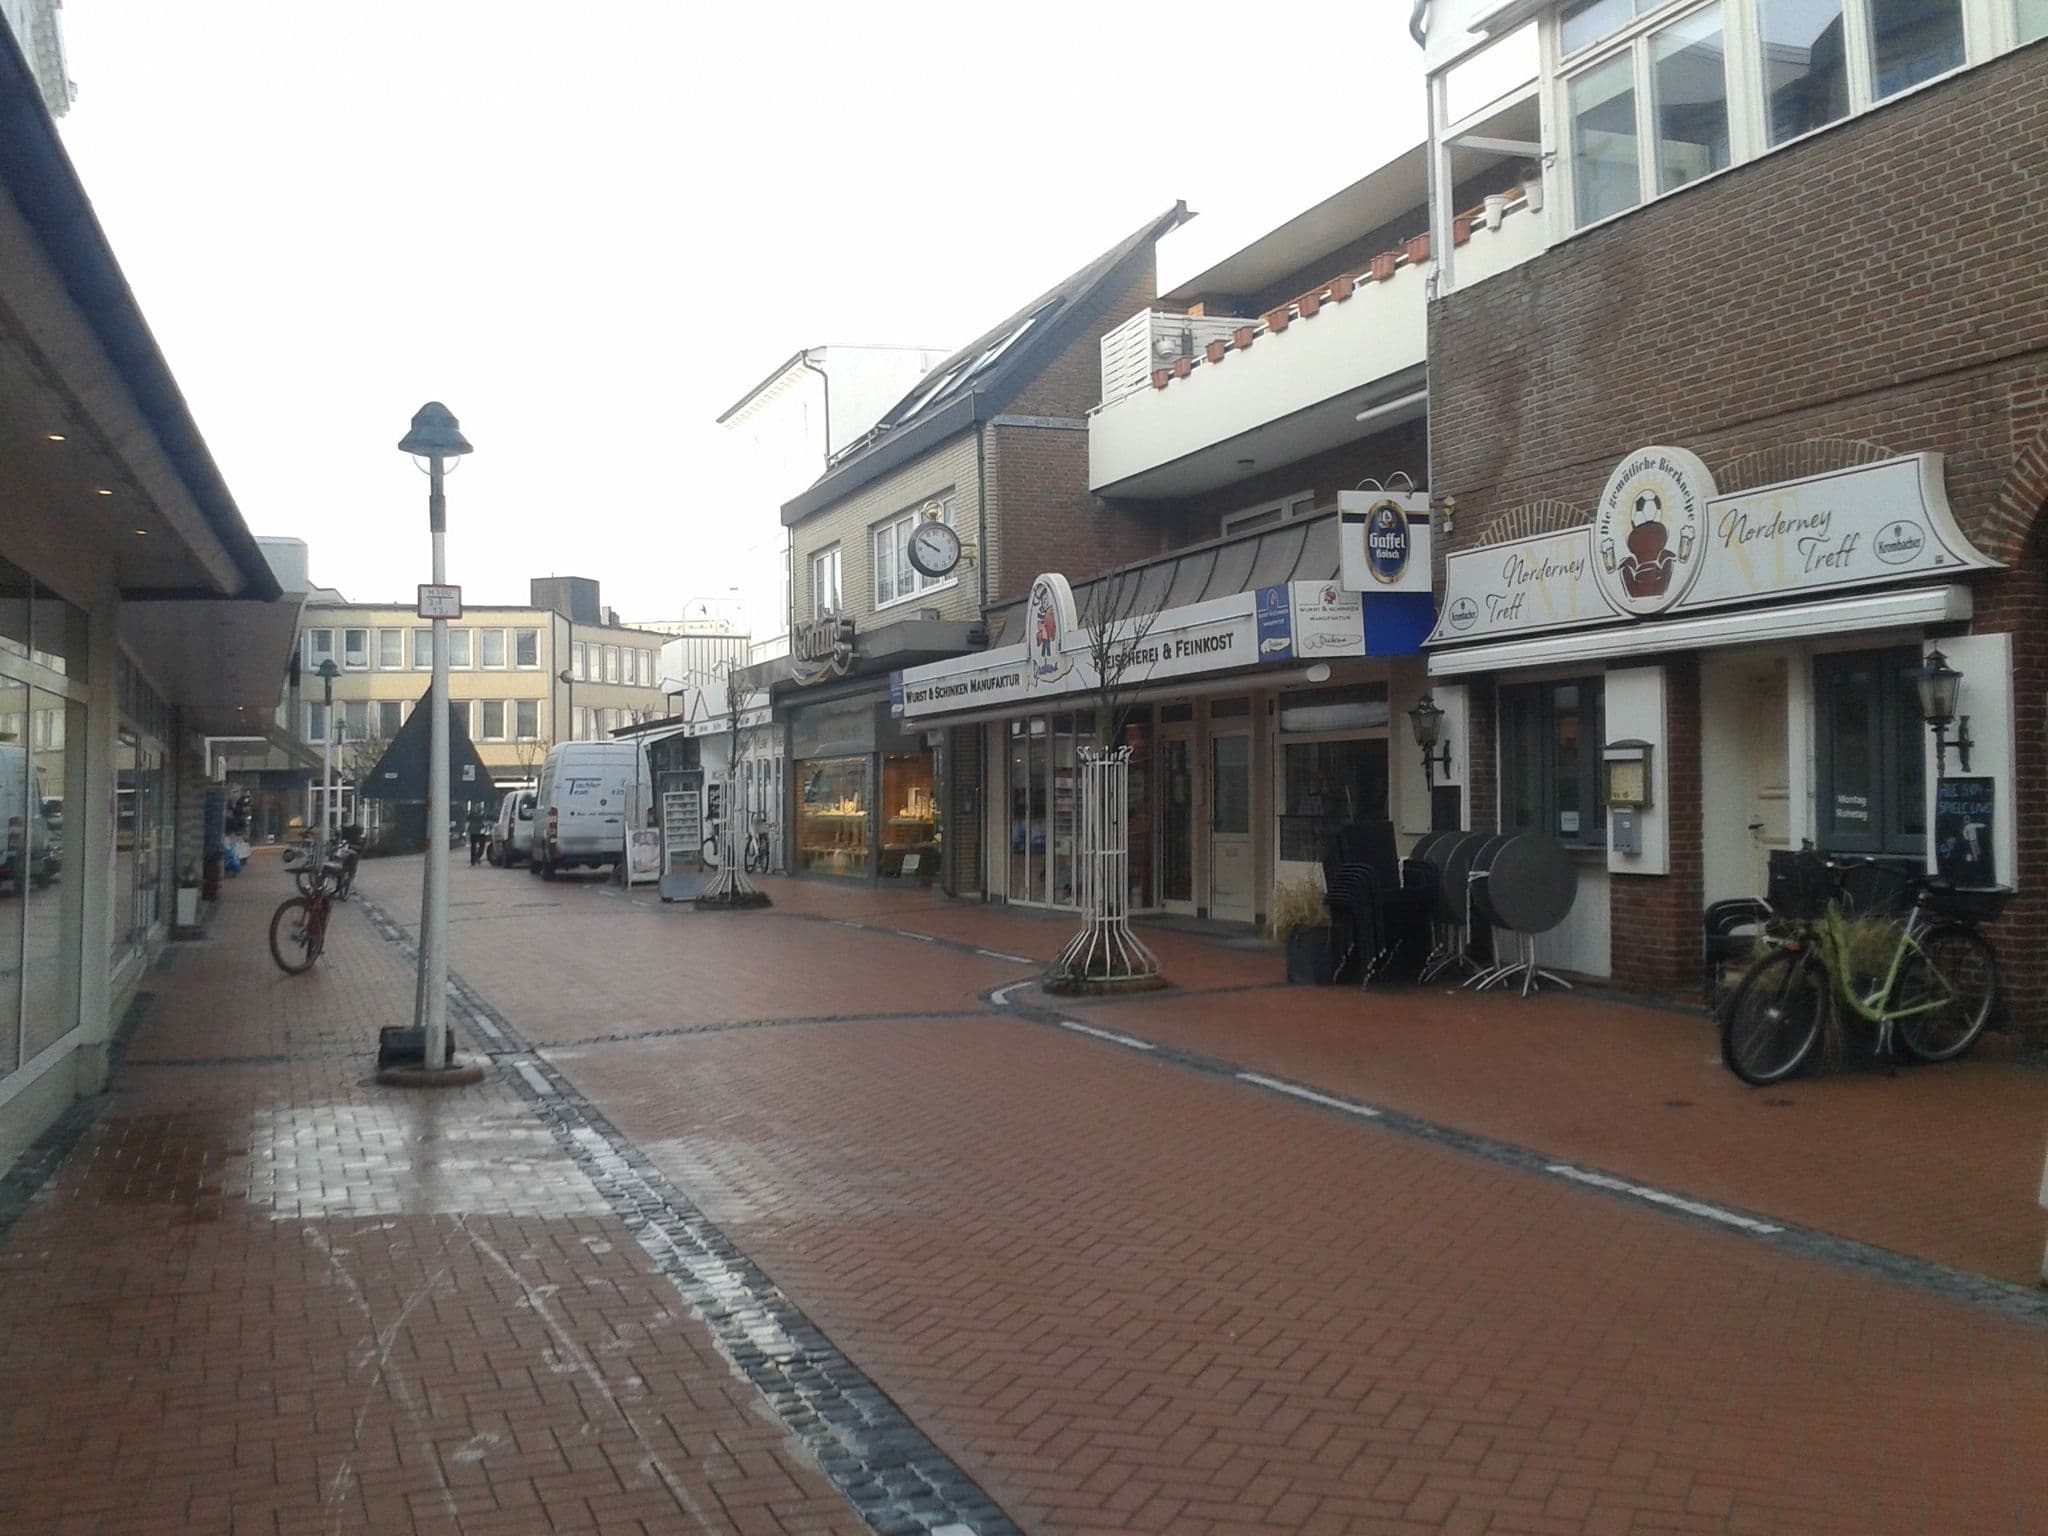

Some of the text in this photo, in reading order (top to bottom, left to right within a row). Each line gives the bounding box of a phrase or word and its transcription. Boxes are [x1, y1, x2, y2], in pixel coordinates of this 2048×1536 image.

[1601, 511, 1611, 535] Die
[1658, 457, 1695, 521] Bierkneipe
[1369, 532, 1406, 549] Gaffel
[1718, 508, 1832, 548] Norderney
[1798, 532, 1860, 573] Treff
[1878, 537, 1921, 554] Krombacher
[1502, 554, 1585, 587] Norderney
[1485, 592, 1526, 623] Treff
[1163, 643, 1172, 660] &
[1176, 632, 1234, 658] FEINKOST
[906, 673, 1020, 704] WURST & SCHINKEN MANUFAKTUR
